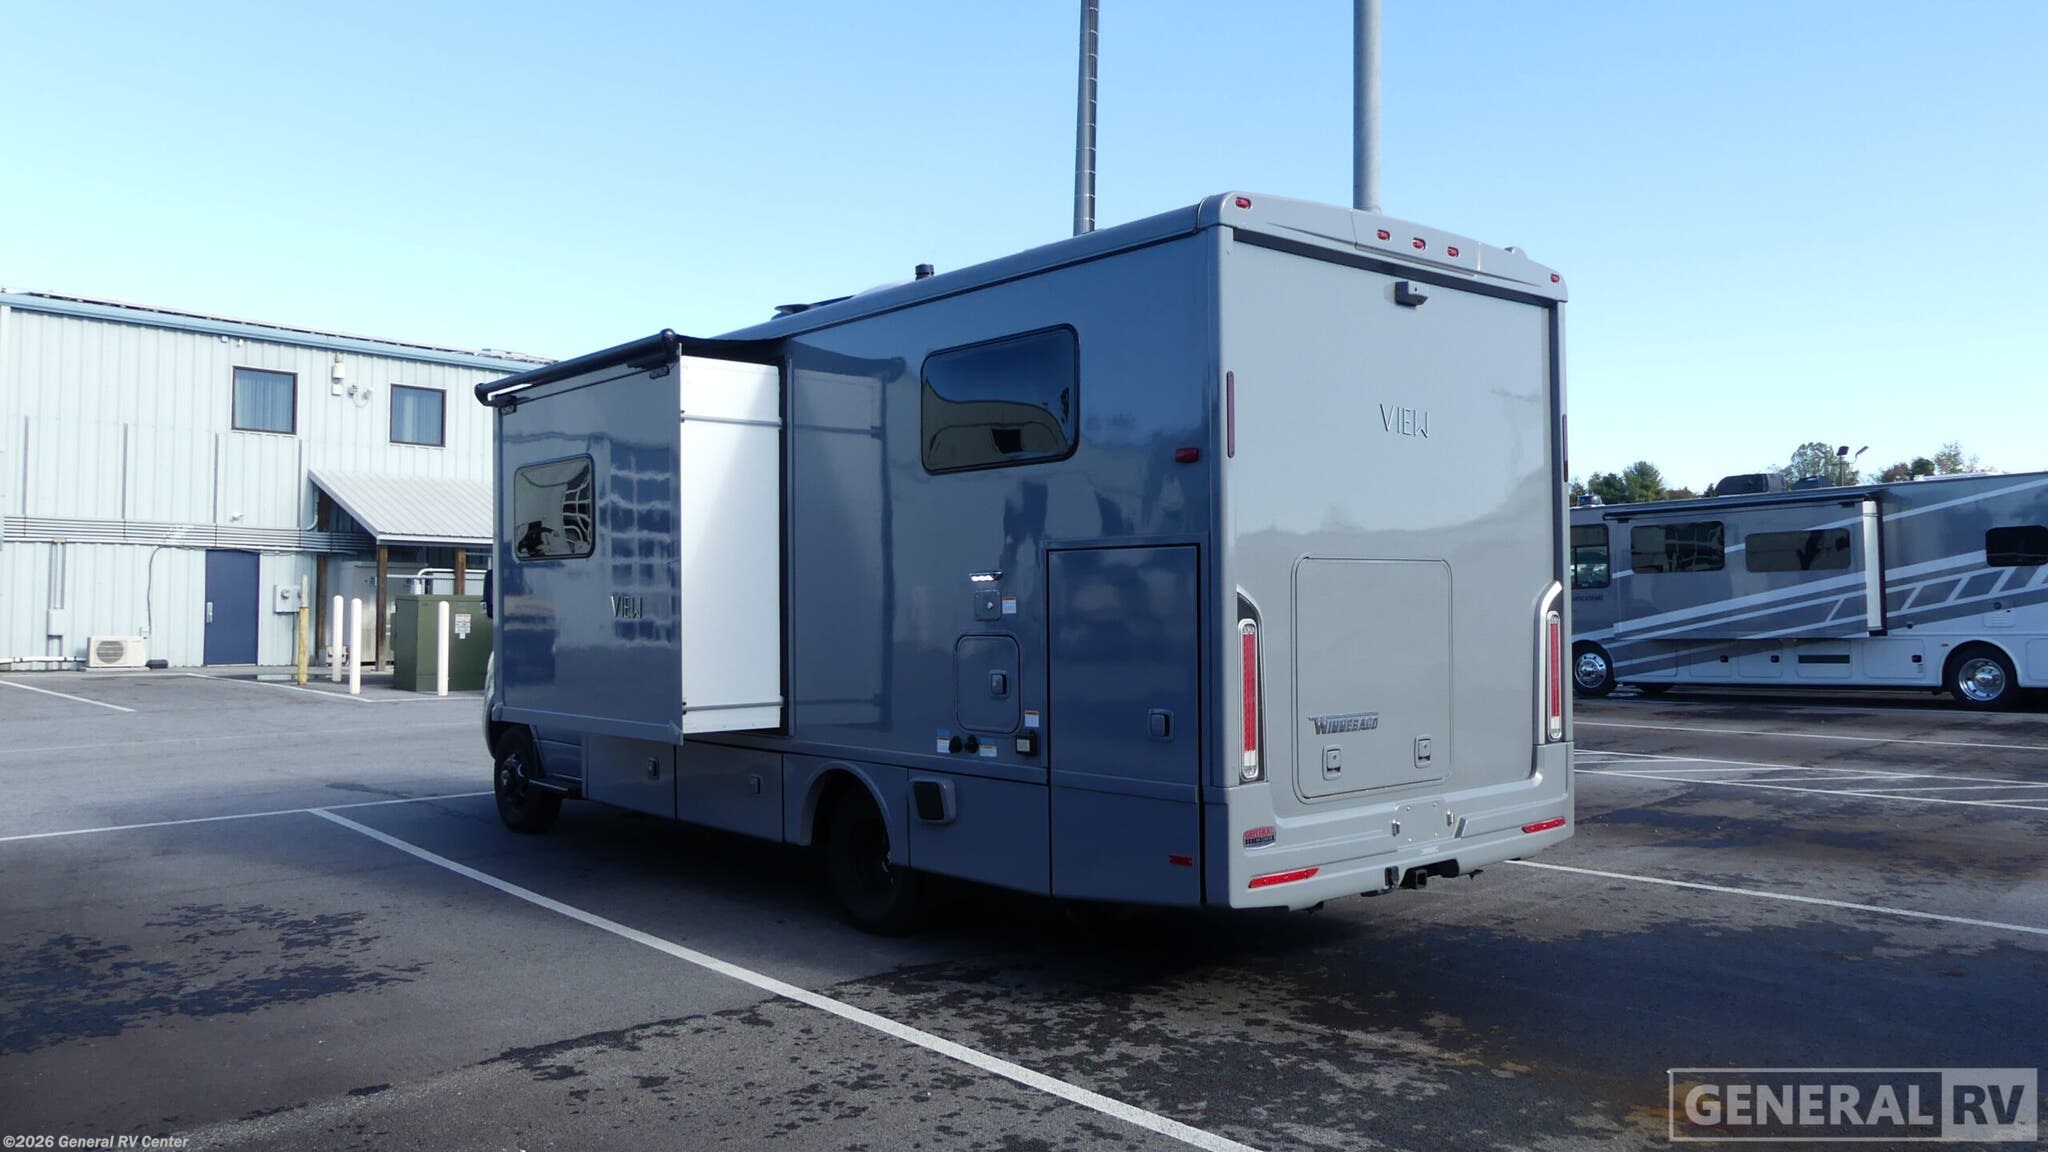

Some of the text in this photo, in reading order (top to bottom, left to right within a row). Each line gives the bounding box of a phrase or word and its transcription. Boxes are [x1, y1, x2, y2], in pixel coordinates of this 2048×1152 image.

[1379, 402, 1430, 439] VIEW
[610, 595, 643, 619] VIEW
[1308, 712, 1378, 735] WINNEBAGO
